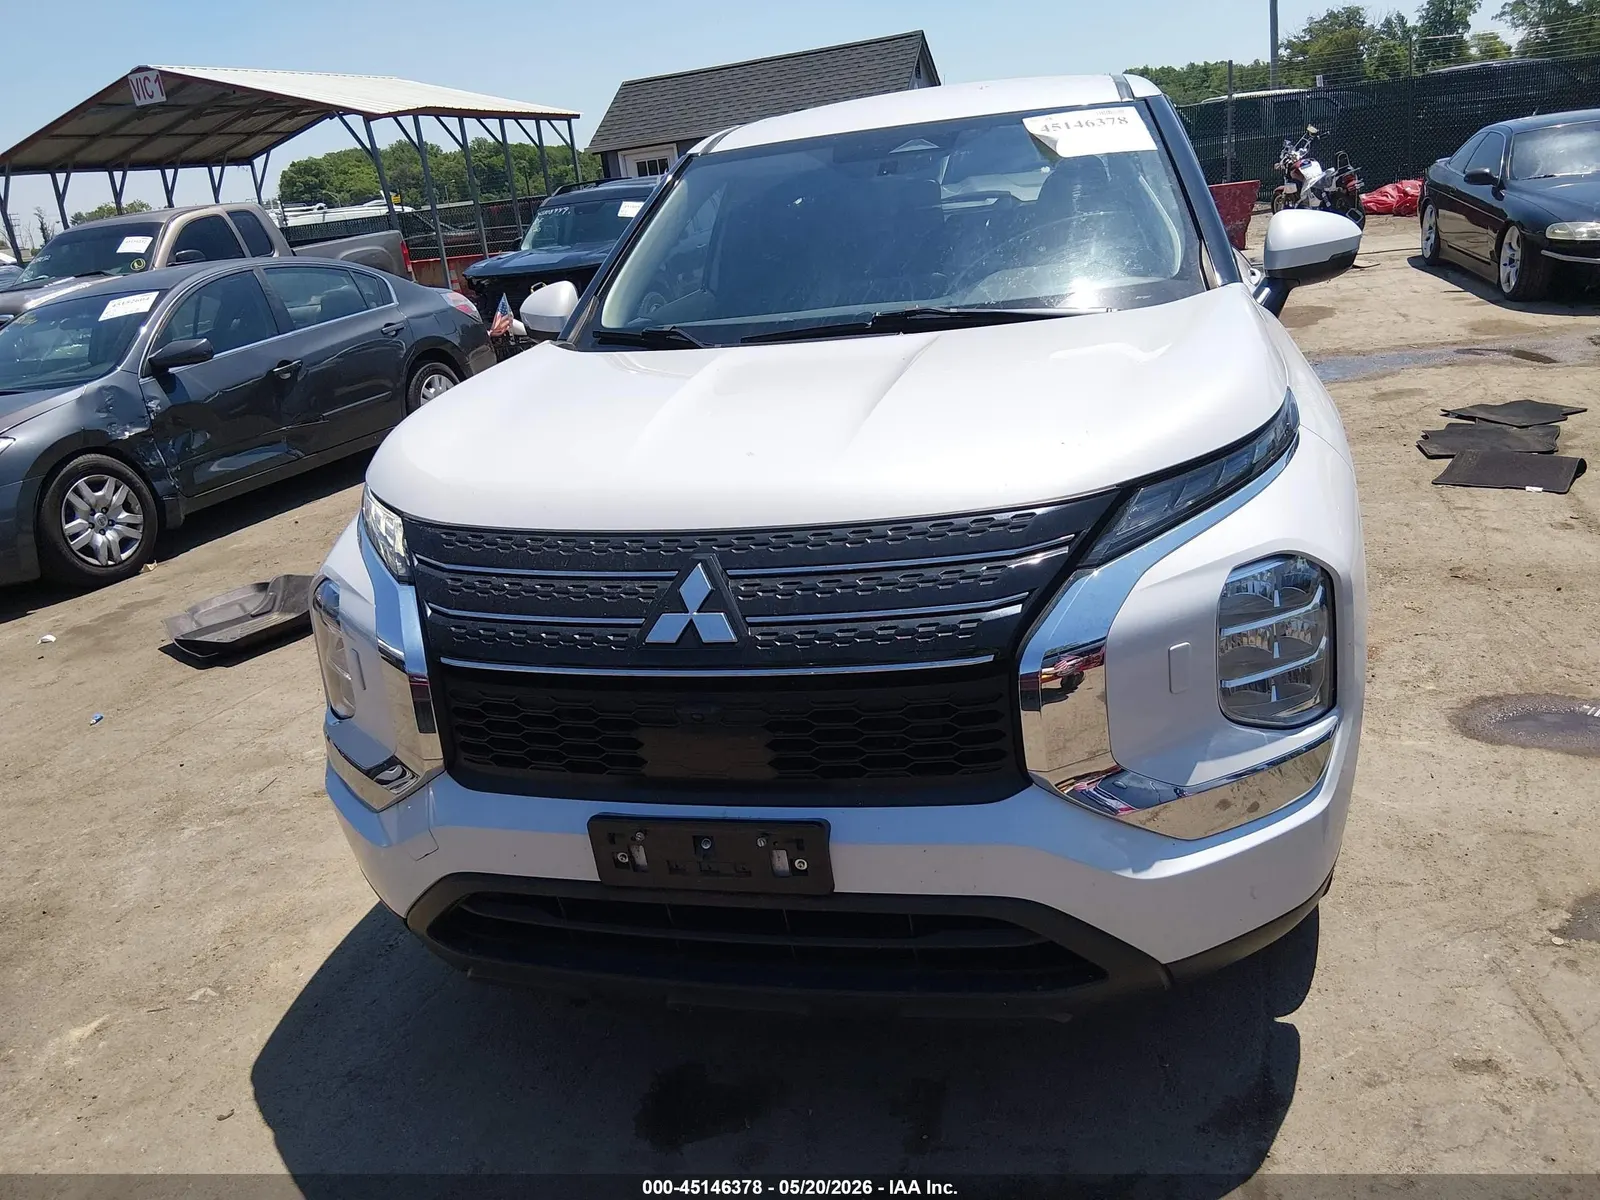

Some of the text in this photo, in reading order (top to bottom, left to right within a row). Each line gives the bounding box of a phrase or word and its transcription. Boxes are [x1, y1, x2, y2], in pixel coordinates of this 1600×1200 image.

[130, 74, 164, 101] VIC 1
[1040, 116, 1129, 133] 45146378
